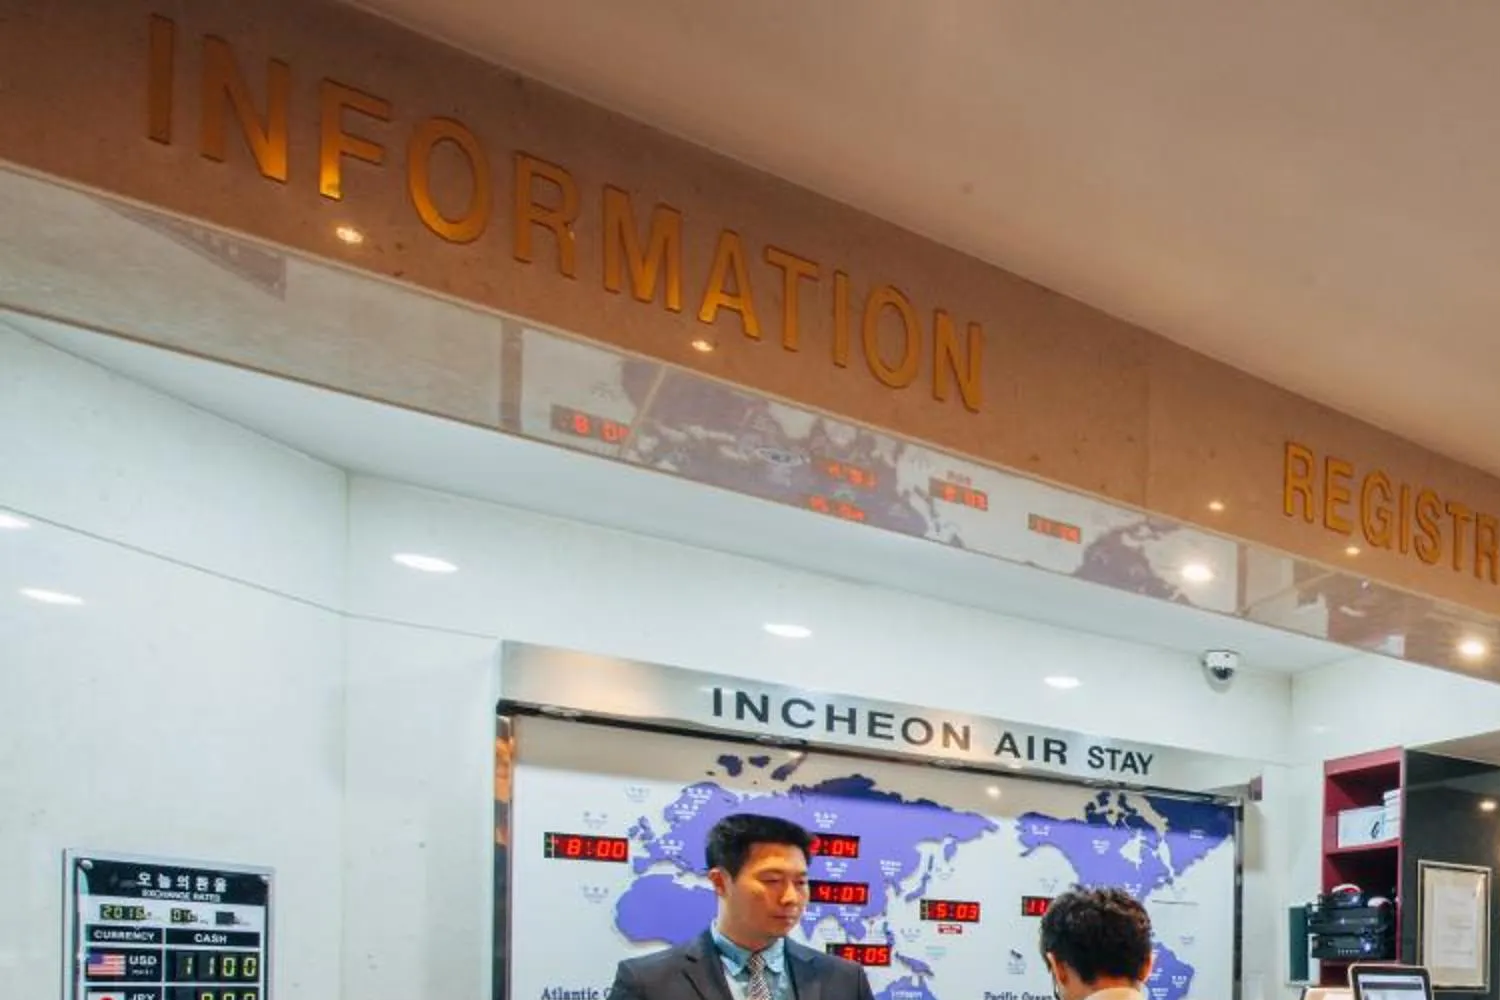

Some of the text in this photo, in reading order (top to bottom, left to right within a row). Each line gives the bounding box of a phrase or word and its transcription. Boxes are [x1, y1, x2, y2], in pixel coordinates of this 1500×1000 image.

[147, 12, 984, 415] INFORMATION
[711, 686, 1155, 777] INCHEON AIR STAY
[93, 929, 155, 942] CURRENCY
[194, 933, 227, 944] CASH
[128, 955, 157, 966] USD
[184, 956, 257, 977] 1100
[541, 986, 600, 1000] Atlantic
